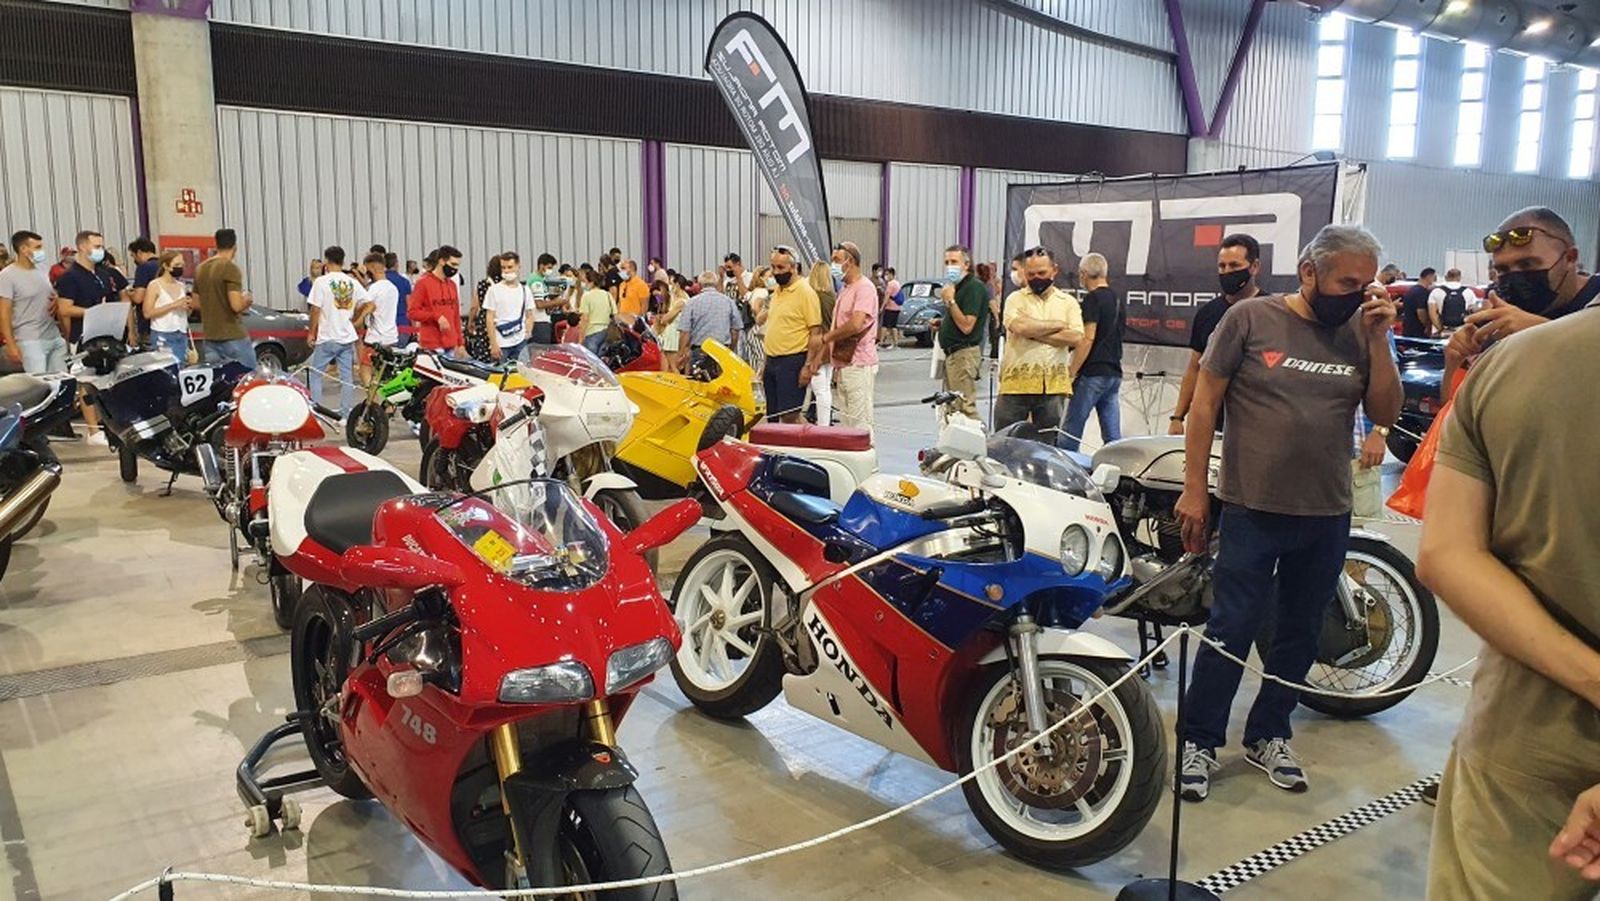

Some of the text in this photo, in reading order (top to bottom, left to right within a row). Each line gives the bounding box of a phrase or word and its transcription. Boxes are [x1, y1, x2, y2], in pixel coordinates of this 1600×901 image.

[1281, 357, 1356, 376] DAINESE
[184, 374, 207, 395] 62
[808, 613, 893, 730] HONDA
[400, 703, 437, 745] 748
